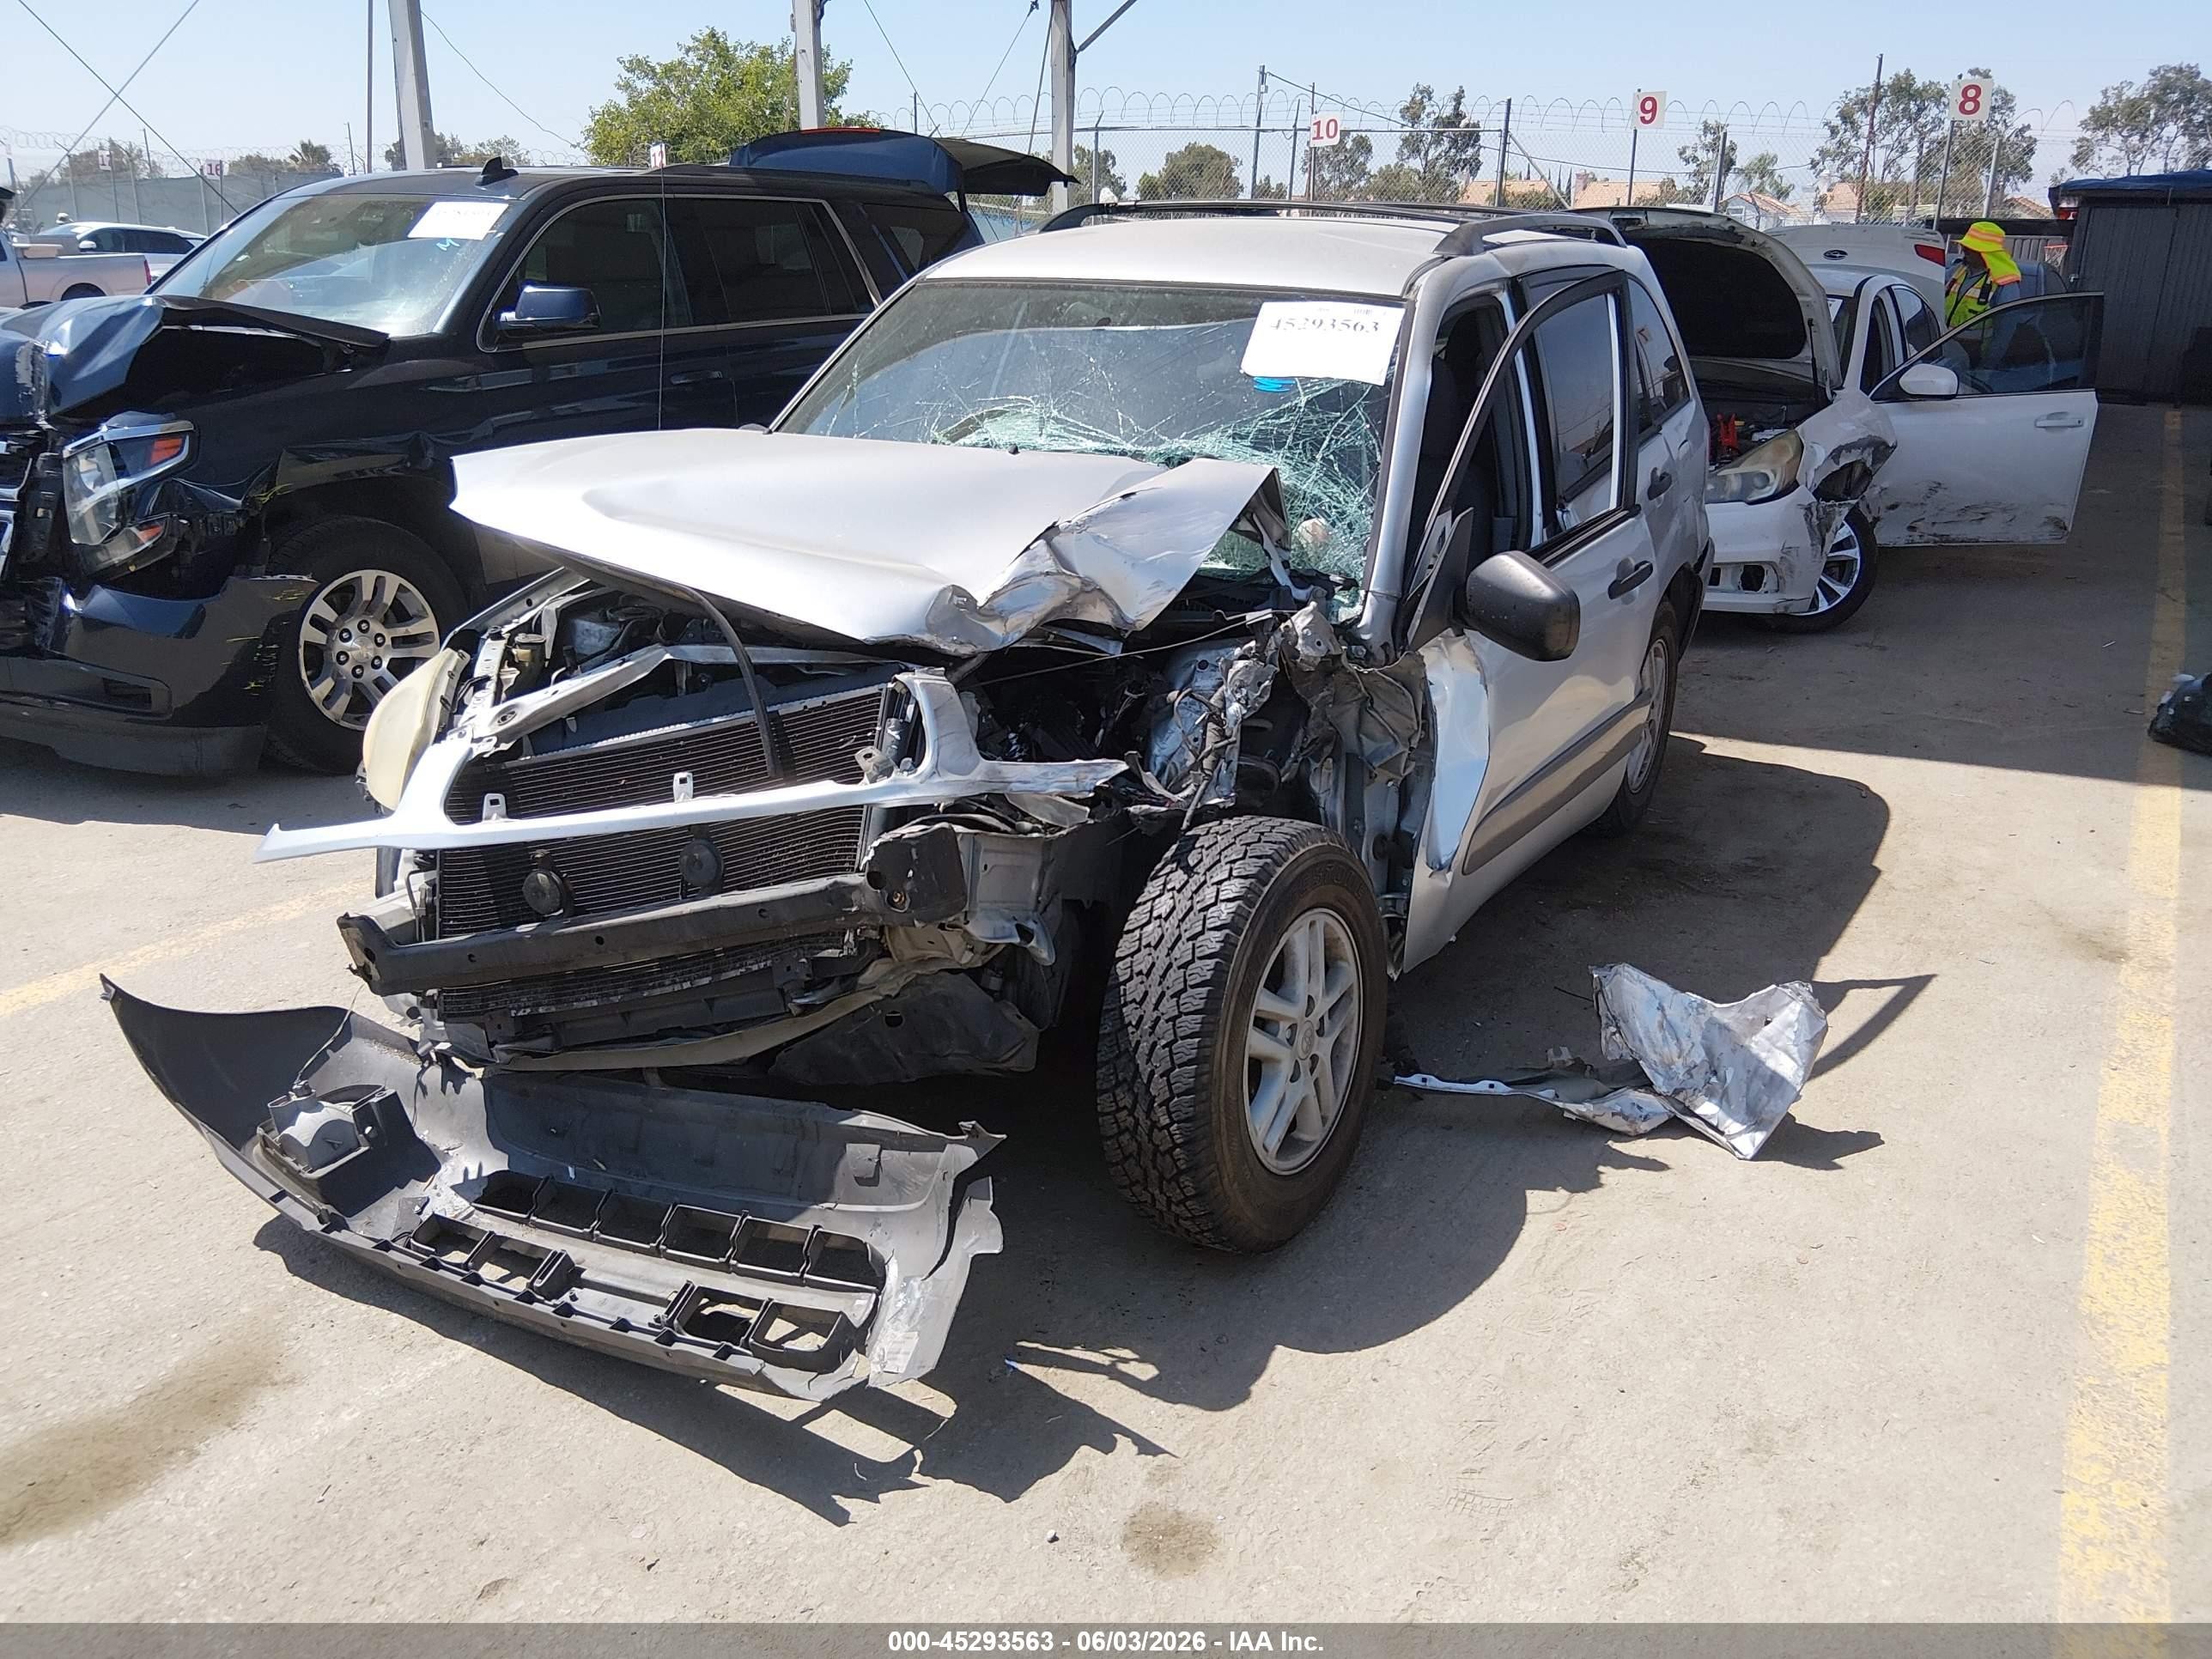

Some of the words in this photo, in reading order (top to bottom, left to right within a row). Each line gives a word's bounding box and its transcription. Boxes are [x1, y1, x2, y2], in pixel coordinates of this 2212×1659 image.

[1640, 96, 1658, 125] 9
[1958, 83, 1982, 116] 8
[1312, 118, 1338, 141] 10
